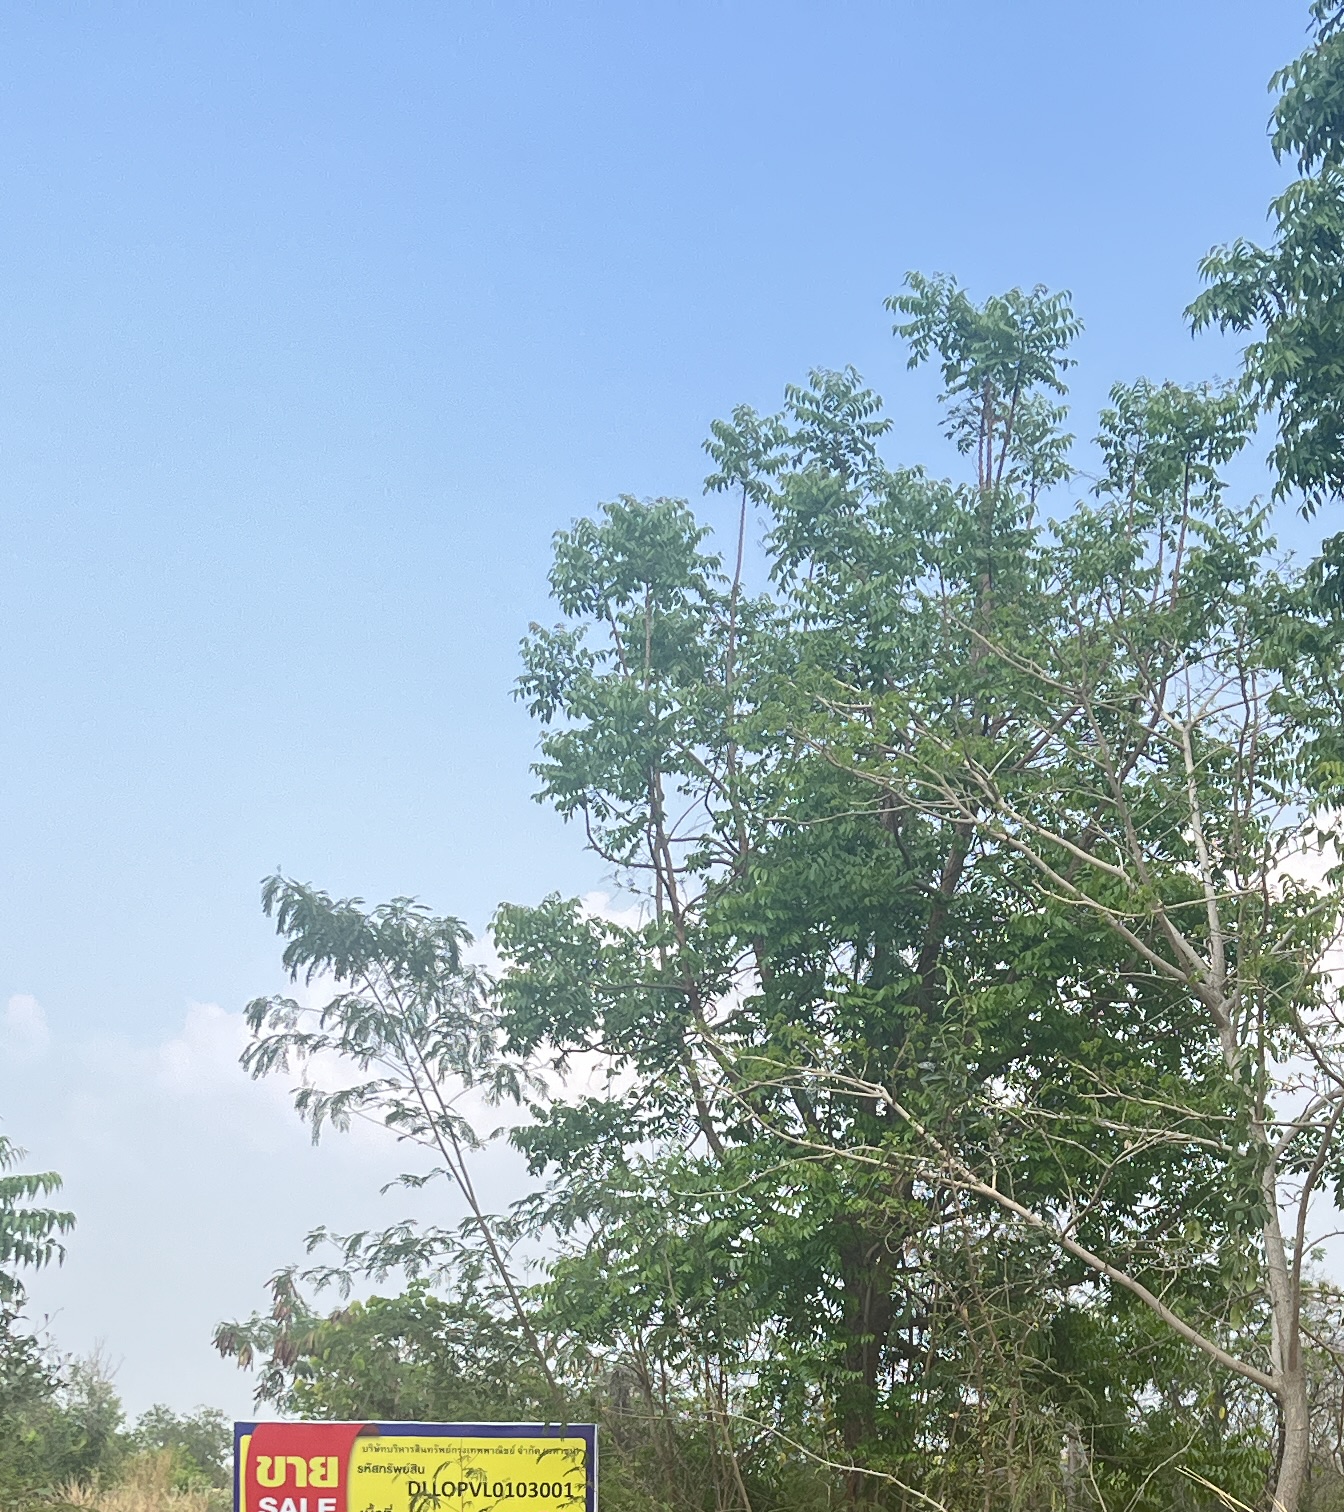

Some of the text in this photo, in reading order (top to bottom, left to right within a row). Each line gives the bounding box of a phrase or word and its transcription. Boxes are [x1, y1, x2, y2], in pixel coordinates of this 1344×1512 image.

[256, 1456, 338, 1488] ขาย
[357, 1463, 425, 1475] รหัสทรัพย์สิน
